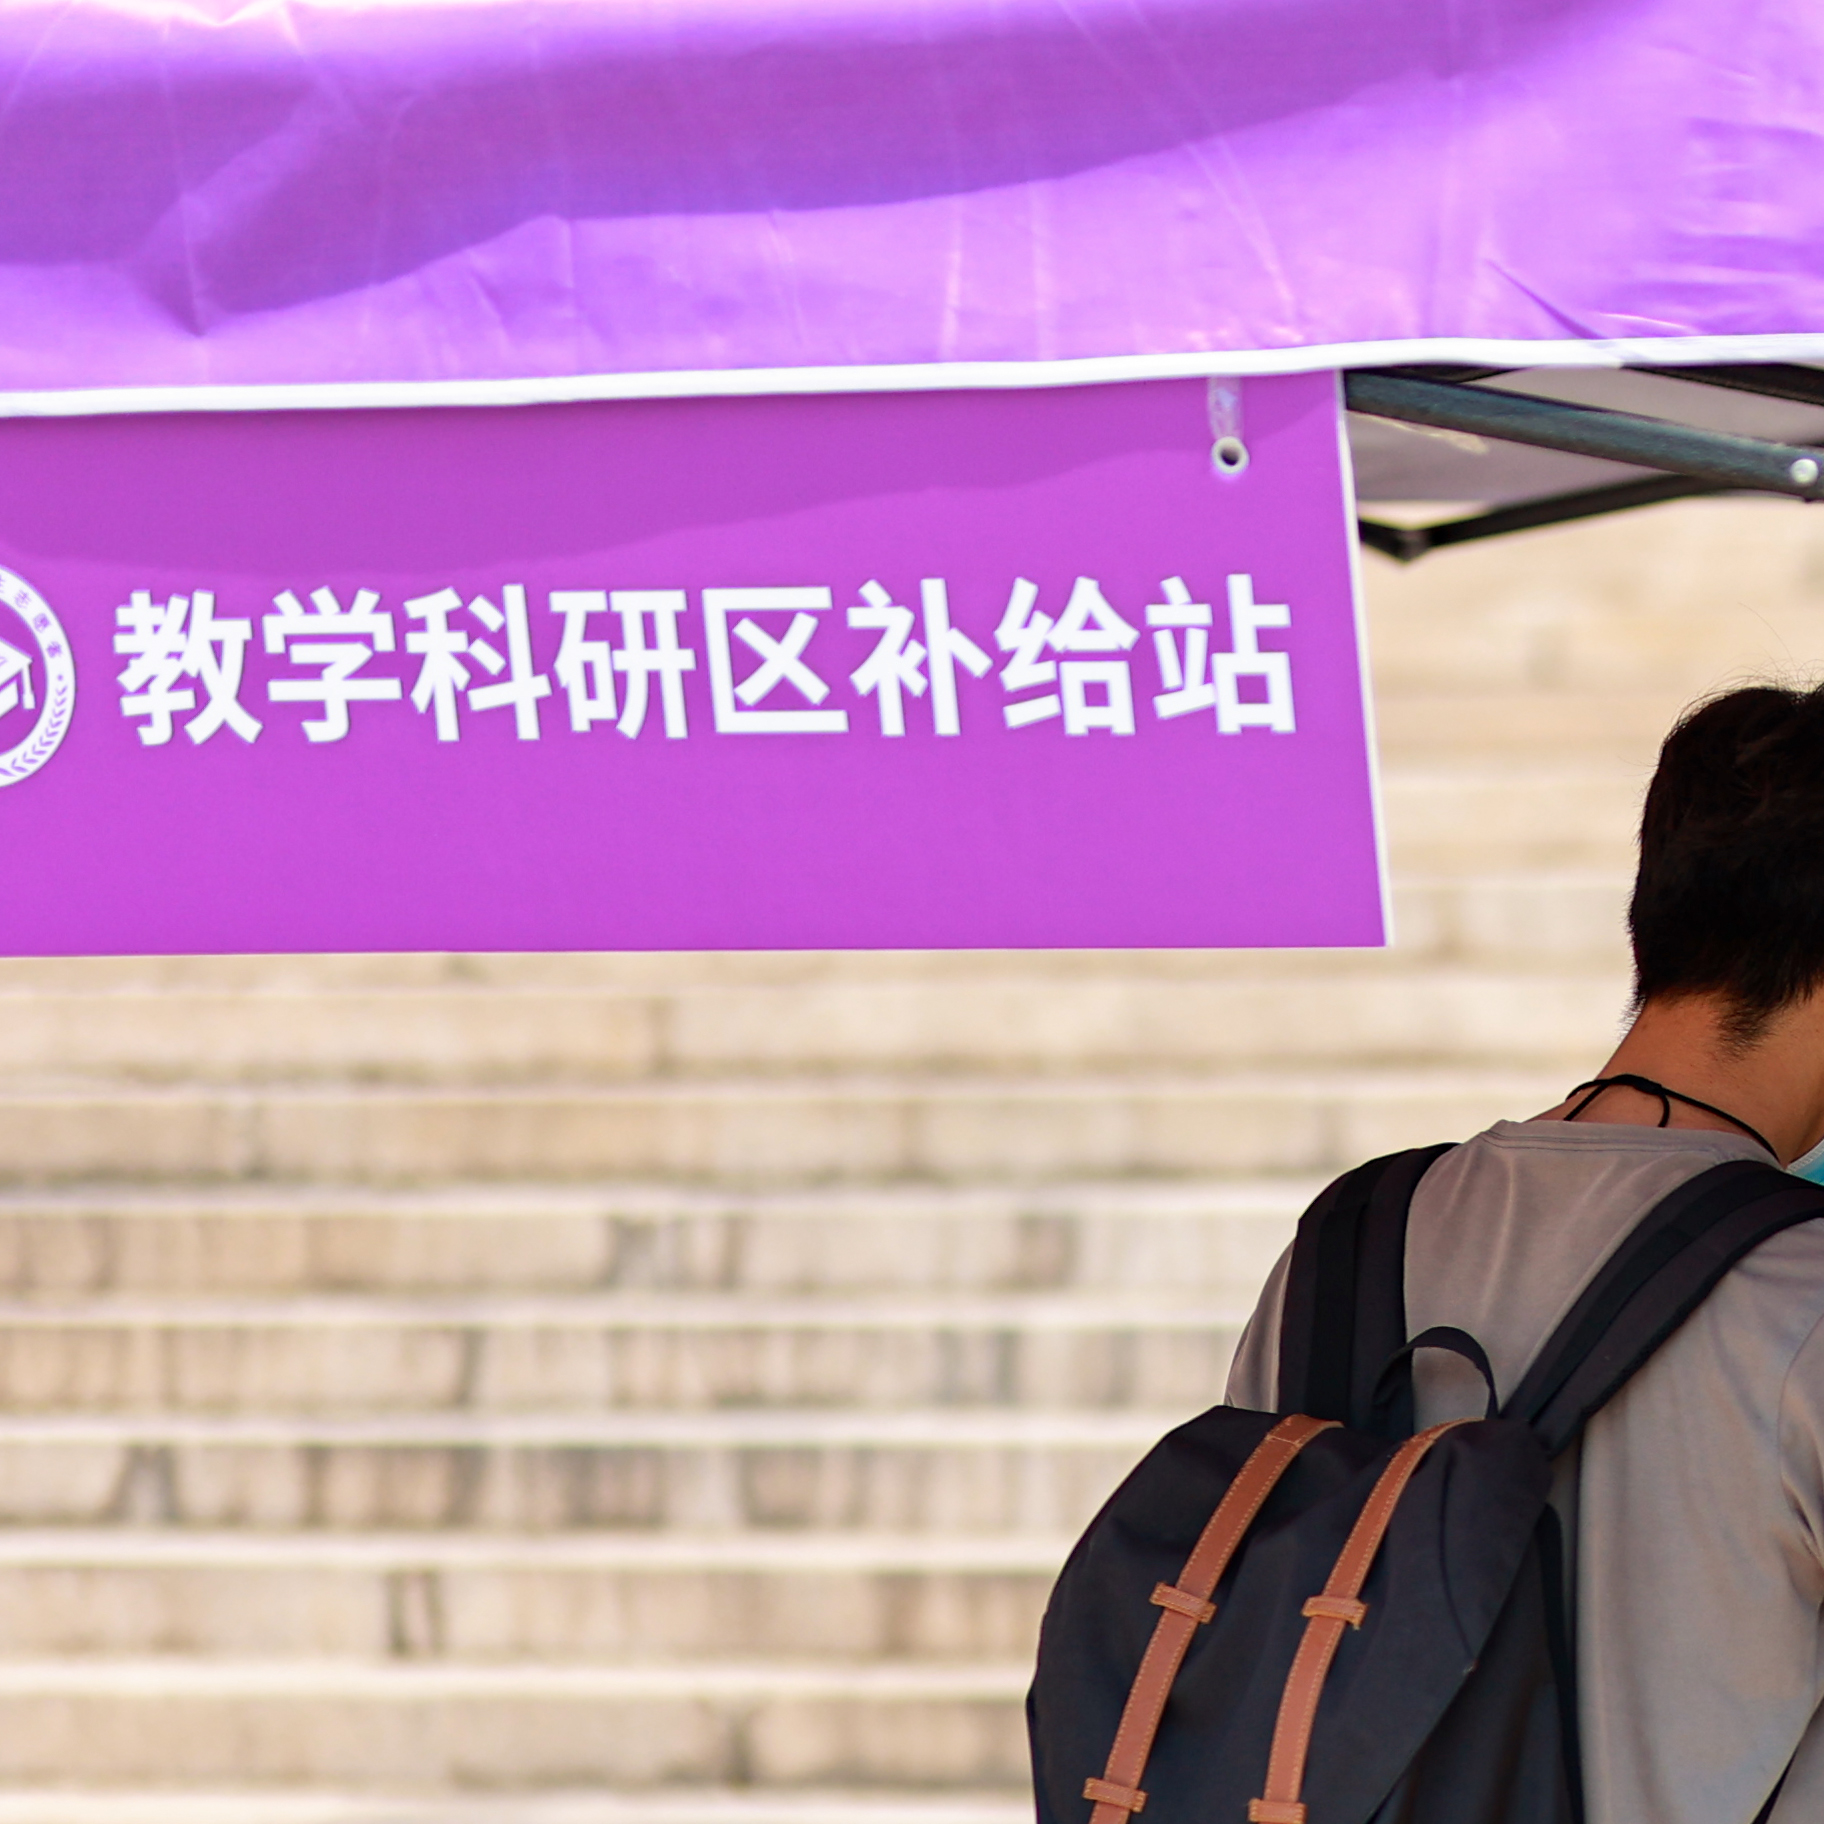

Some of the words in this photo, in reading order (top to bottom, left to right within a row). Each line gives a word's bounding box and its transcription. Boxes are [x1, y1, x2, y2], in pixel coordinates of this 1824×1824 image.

[112, 573, 1298, 746] 教学科研区补给站
